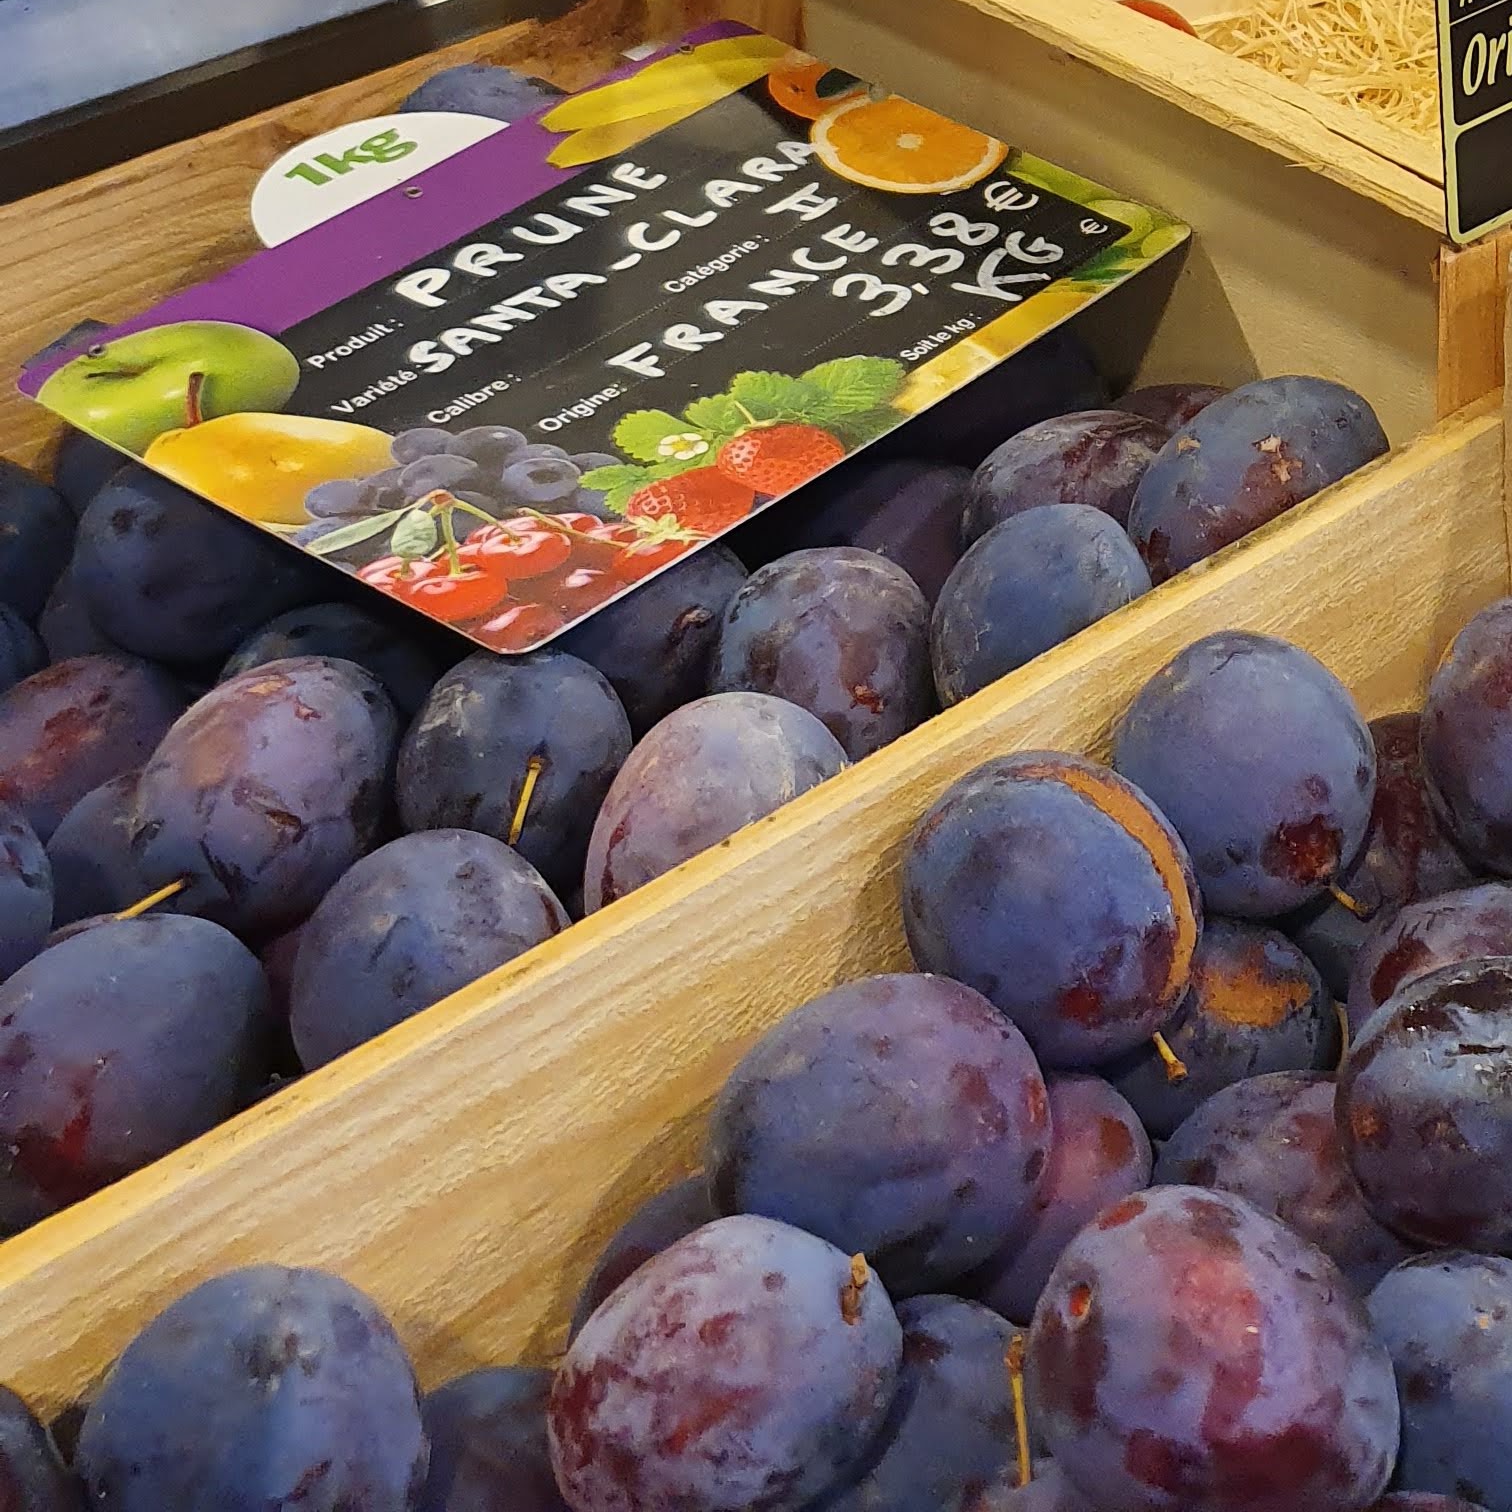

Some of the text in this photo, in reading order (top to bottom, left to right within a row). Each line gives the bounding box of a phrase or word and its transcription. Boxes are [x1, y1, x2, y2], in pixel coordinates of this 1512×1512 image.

[283, 126, 420, 189] 1kg
[393, 160, 669, 309] PRUNE
[1079, 218, 1109, 236] €
[950, 230, 1066, 303] KG
[604, 222, 882, 380] FRANCE
[900, 339, 939, 361] Soit
